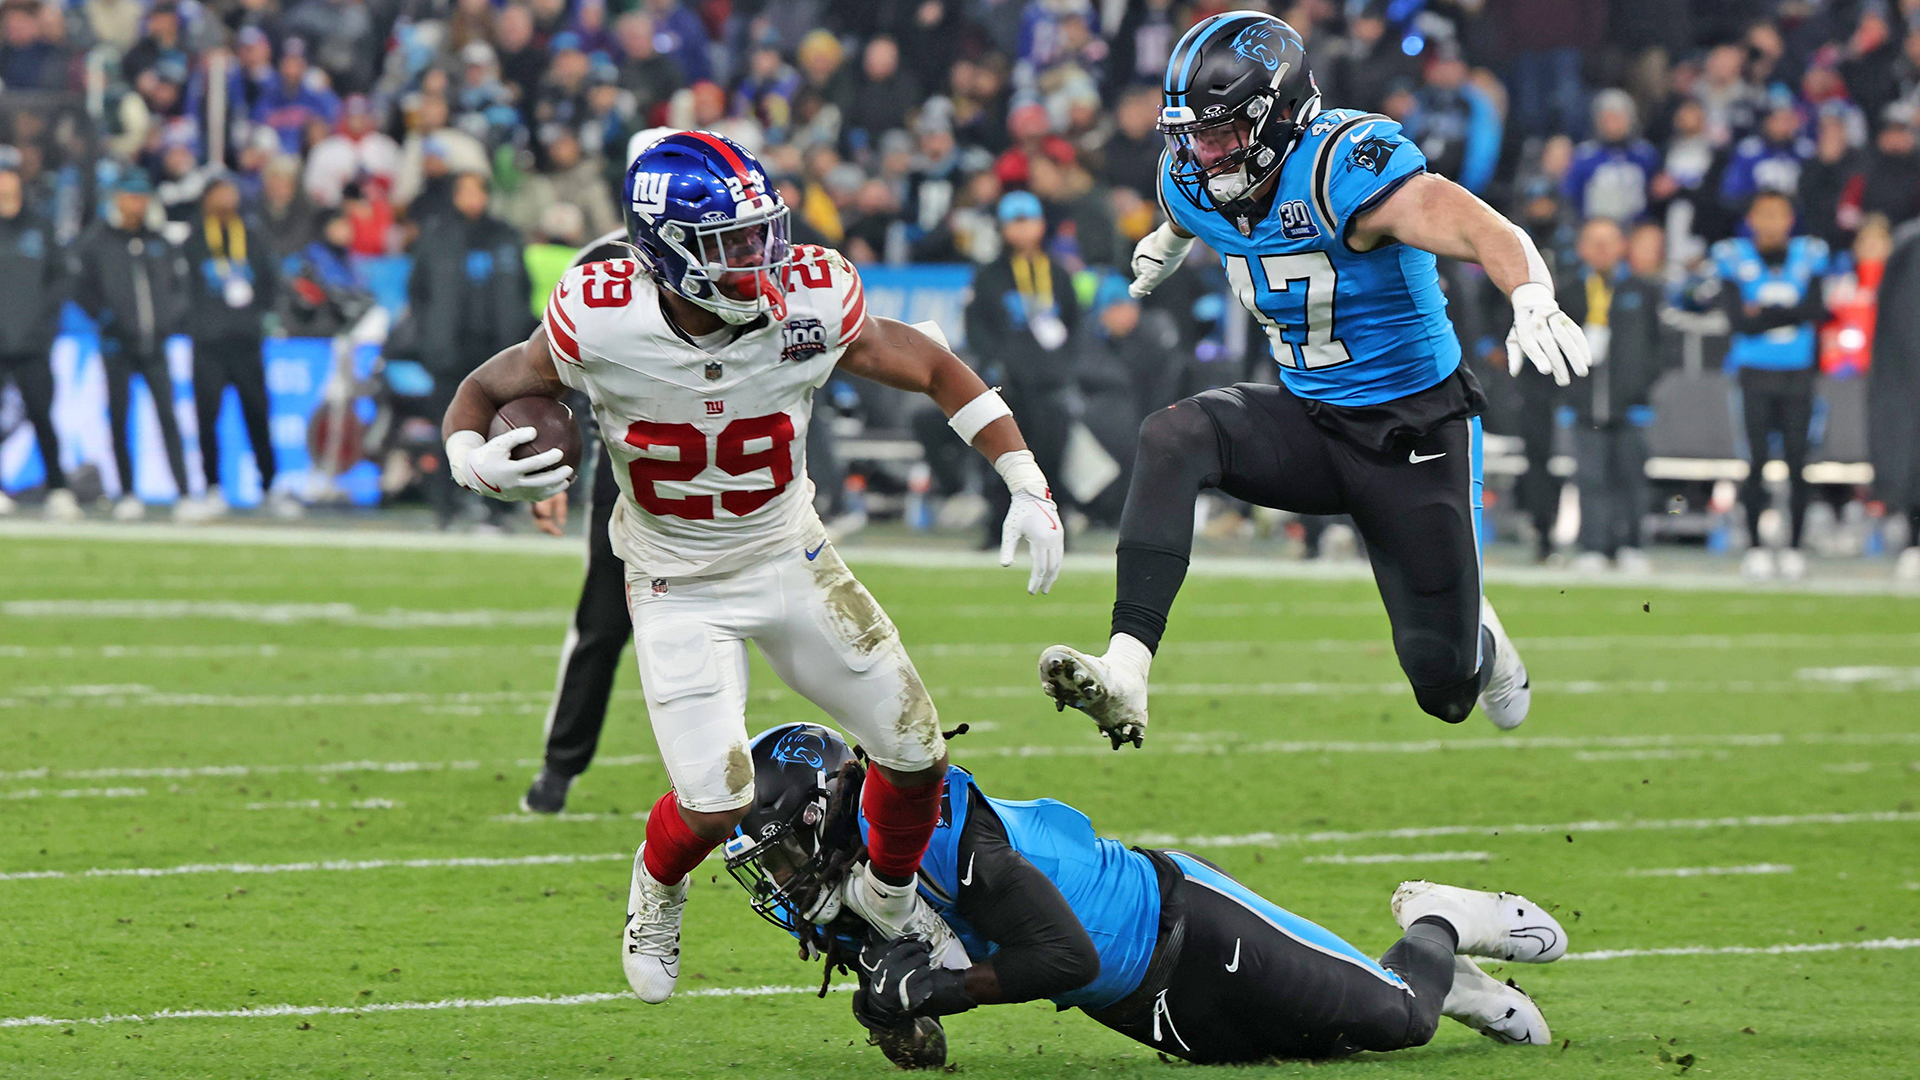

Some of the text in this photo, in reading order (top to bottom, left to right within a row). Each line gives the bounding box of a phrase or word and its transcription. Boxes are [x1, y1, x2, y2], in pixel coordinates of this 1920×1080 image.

[1311, 111, 1348, 136] 47
[724, 169, 765, 203] 29
[1281, 203, 1310, 228] 30
[583, 260, 634, 308] 29
[1225, 250, 1353, 370] 47
[783, 326, 826, 349] 100
[624, 411, 795, 521] 29
